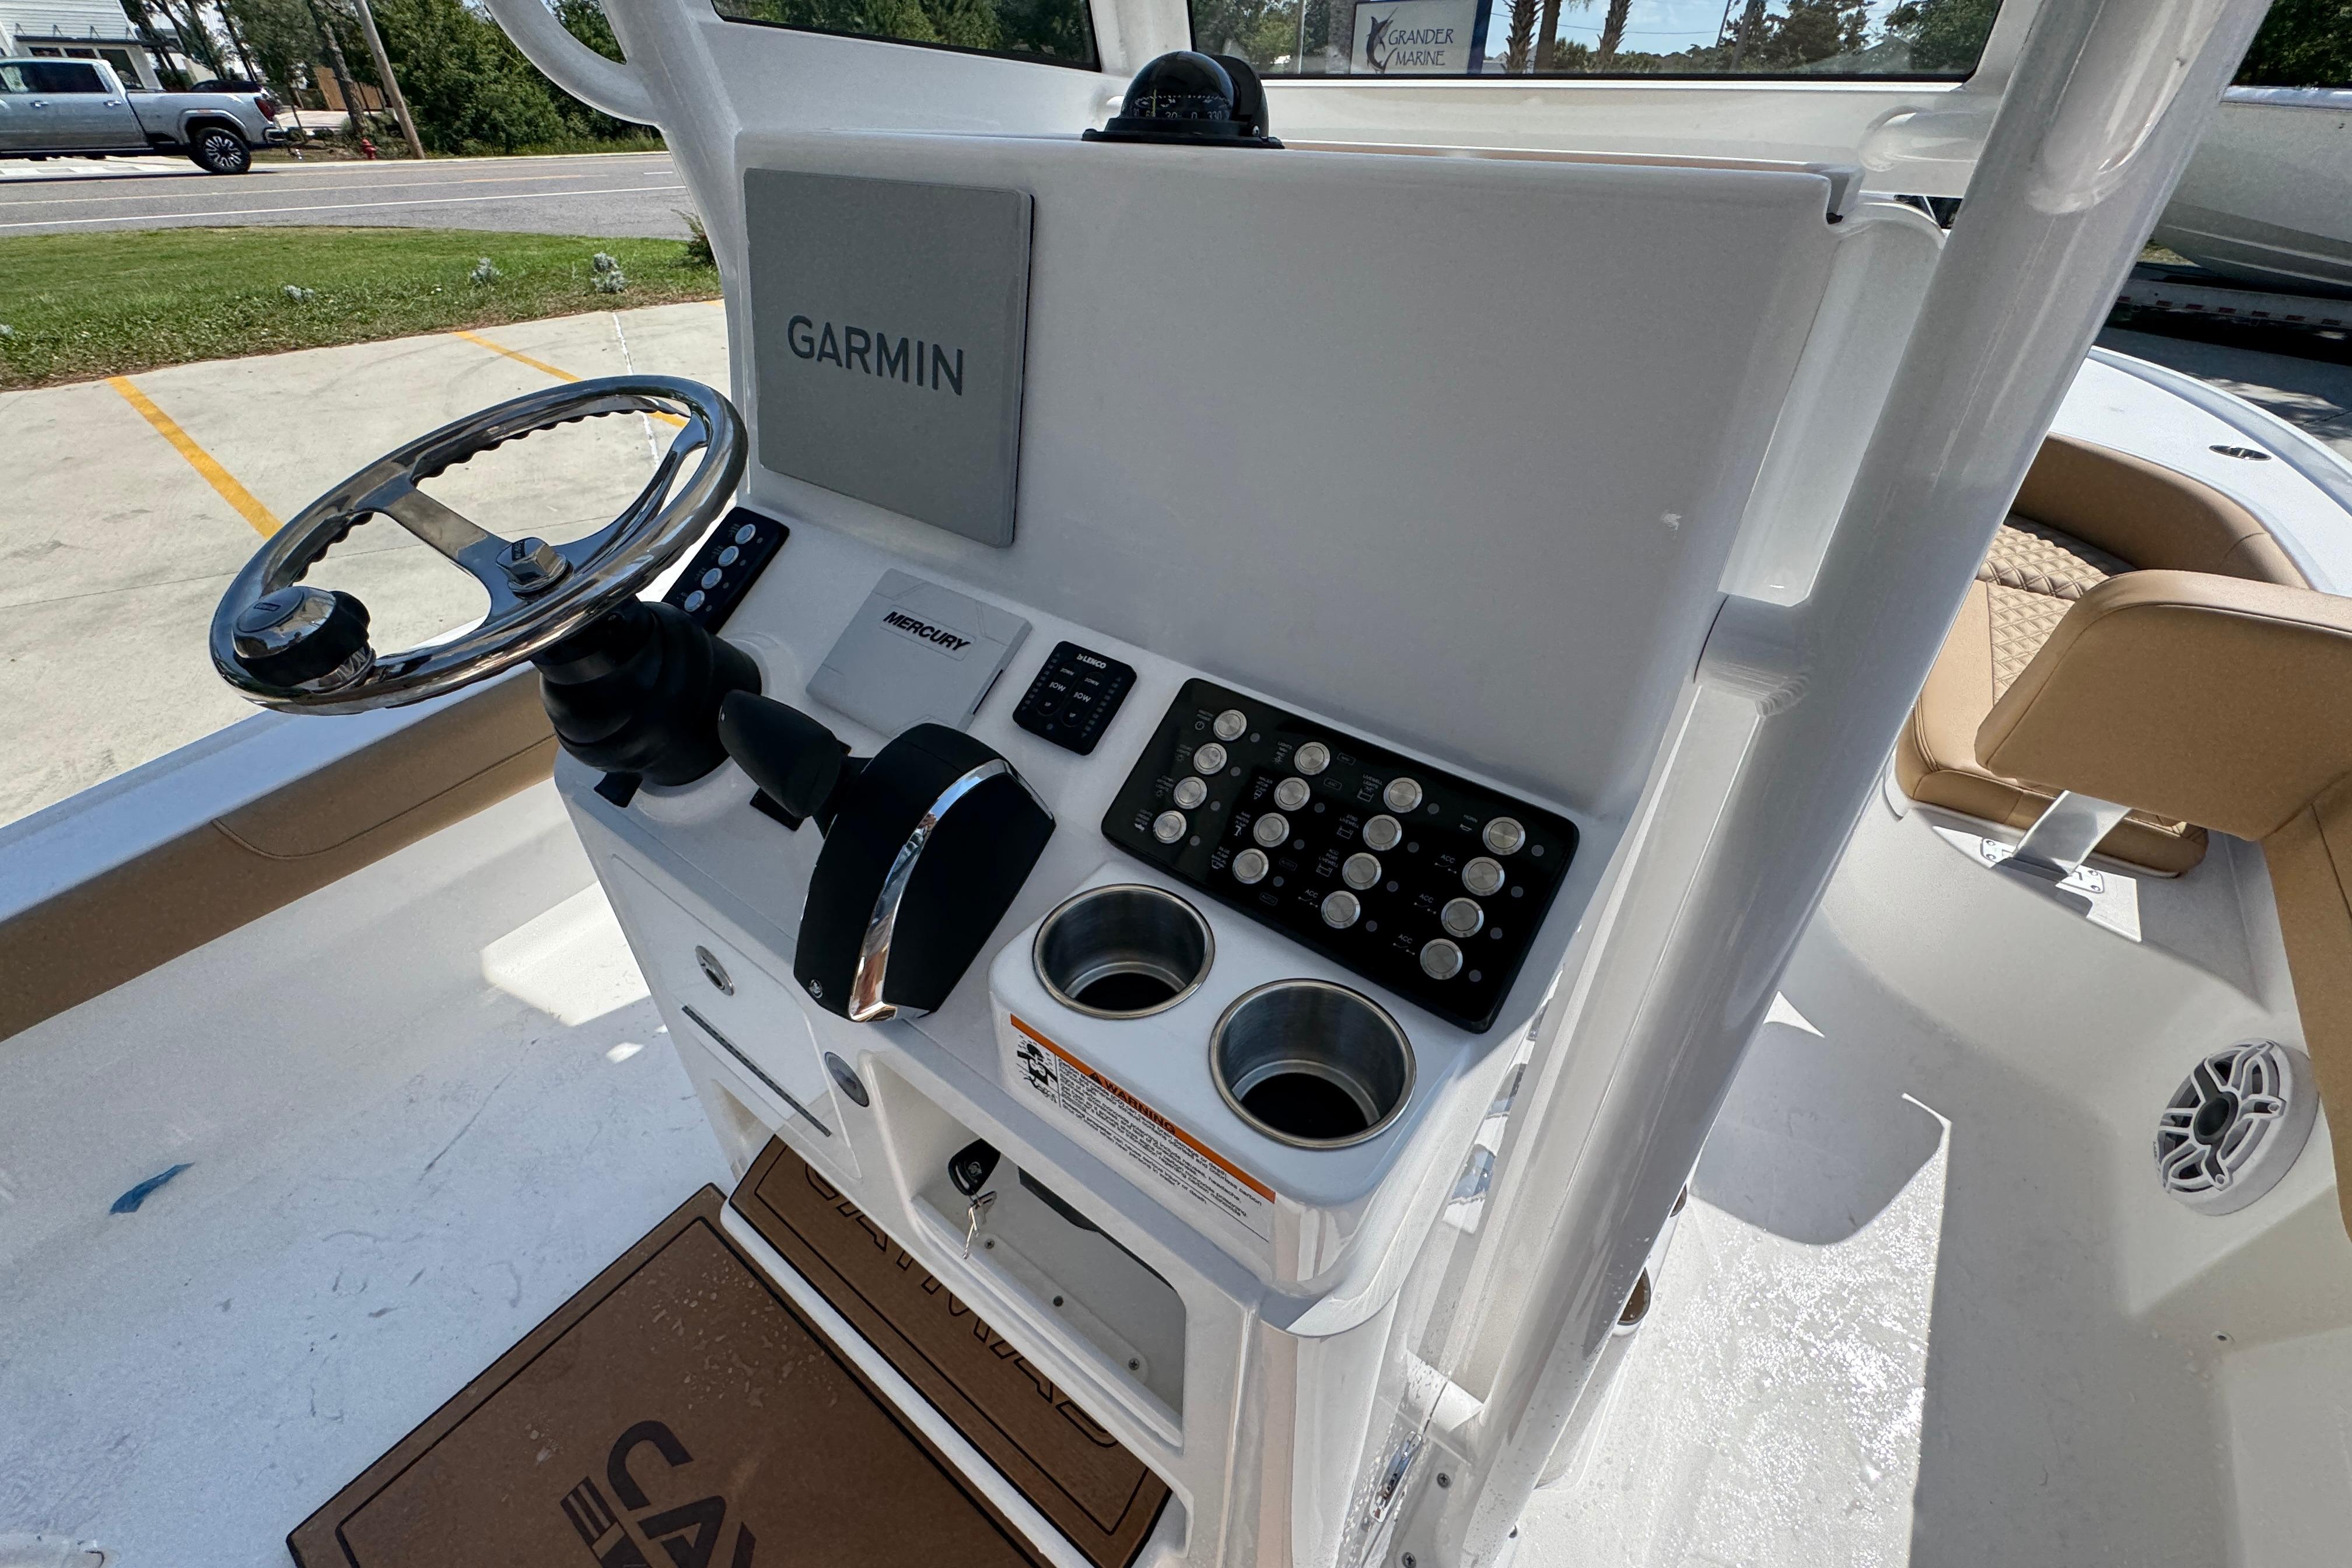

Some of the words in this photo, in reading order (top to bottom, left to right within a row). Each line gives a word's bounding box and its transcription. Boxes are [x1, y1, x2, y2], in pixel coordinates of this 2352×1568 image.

[1388, 29, 1454, 45] GRANDER
[1395, 50, 1446, 66] MARINE
[788, 315, 964, 396] GARMIN
[883, 611, 971, 651] MERCURY
[1083, 655, 1107, 668] LENCO
[1440, 854, 1455, 863] ACC
[1304, 888, 1318, 898] ACC
[1419, 894, 1434, 903] ACC
[1398, 934, 1413, 944] ACC
[1104, 1079, 1175, 1135] WARNING
